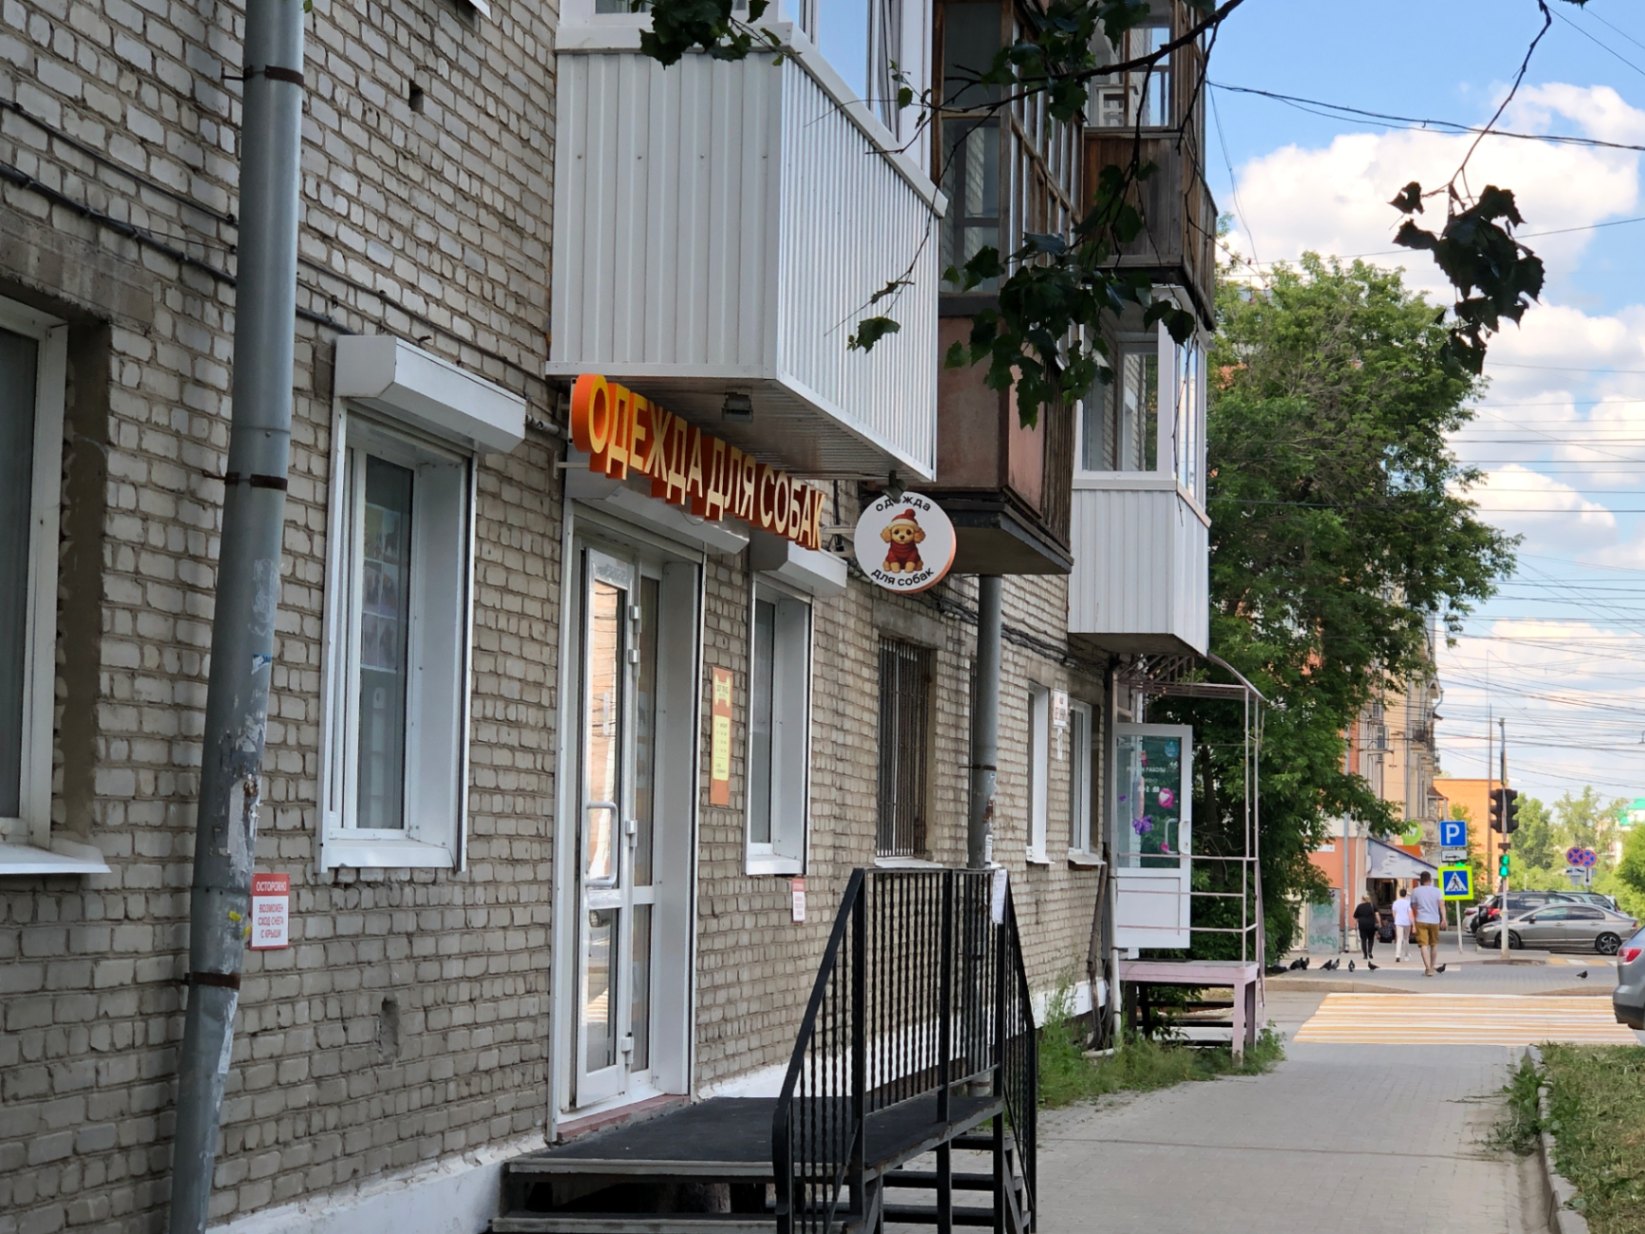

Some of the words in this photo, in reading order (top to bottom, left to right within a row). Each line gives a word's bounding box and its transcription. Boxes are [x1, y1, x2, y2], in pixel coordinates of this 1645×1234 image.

[586, 374, 704, 506] ОДЕЖДА
[705, 436, 756, 522] ДЛЯ
[759, 465, 827, 551] СОБАК
[875, 496, 931, 512] оджда
[871, 569, 896, 585] для
[897, 567, 934, 586] собак
[256, 881, 287, 891] ОСТОРОЖНО
